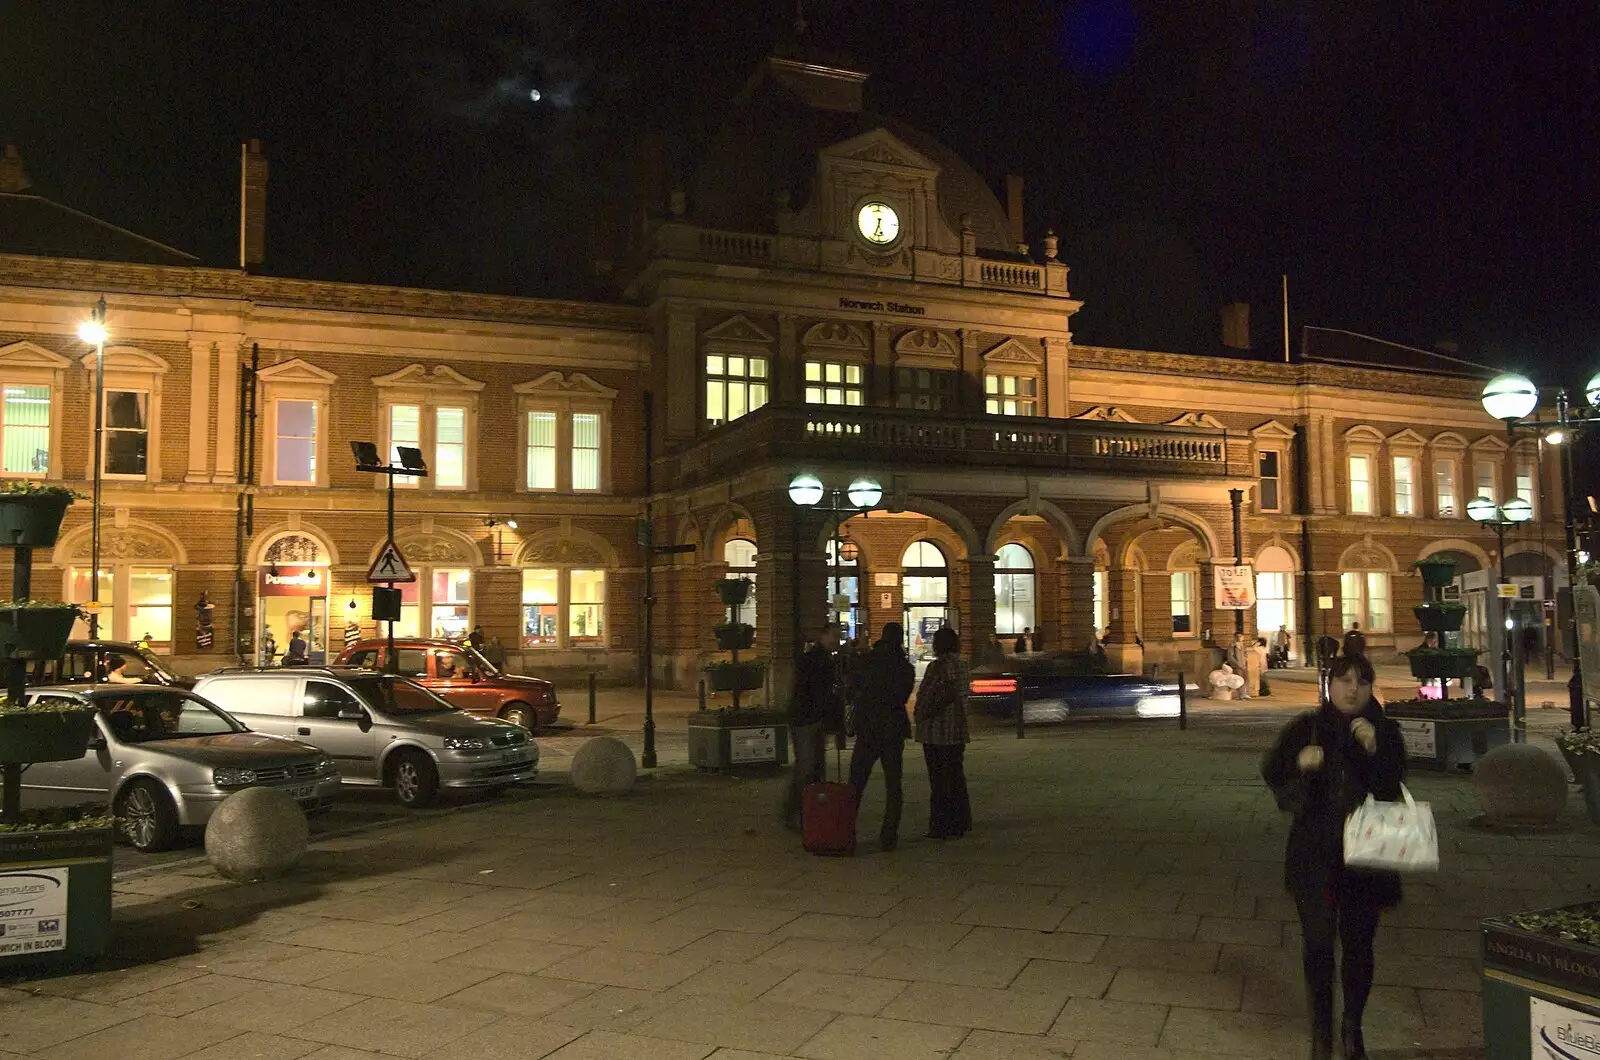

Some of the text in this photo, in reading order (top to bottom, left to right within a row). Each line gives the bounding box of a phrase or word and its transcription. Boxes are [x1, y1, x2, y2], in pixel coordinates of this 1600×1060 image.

[840, 297, 925, 315] Norwich Station
[24, 941, 33, 951] IN
[34, 939, 62, 949] BLOOM
[1536, 953, 1551, 968] IN
